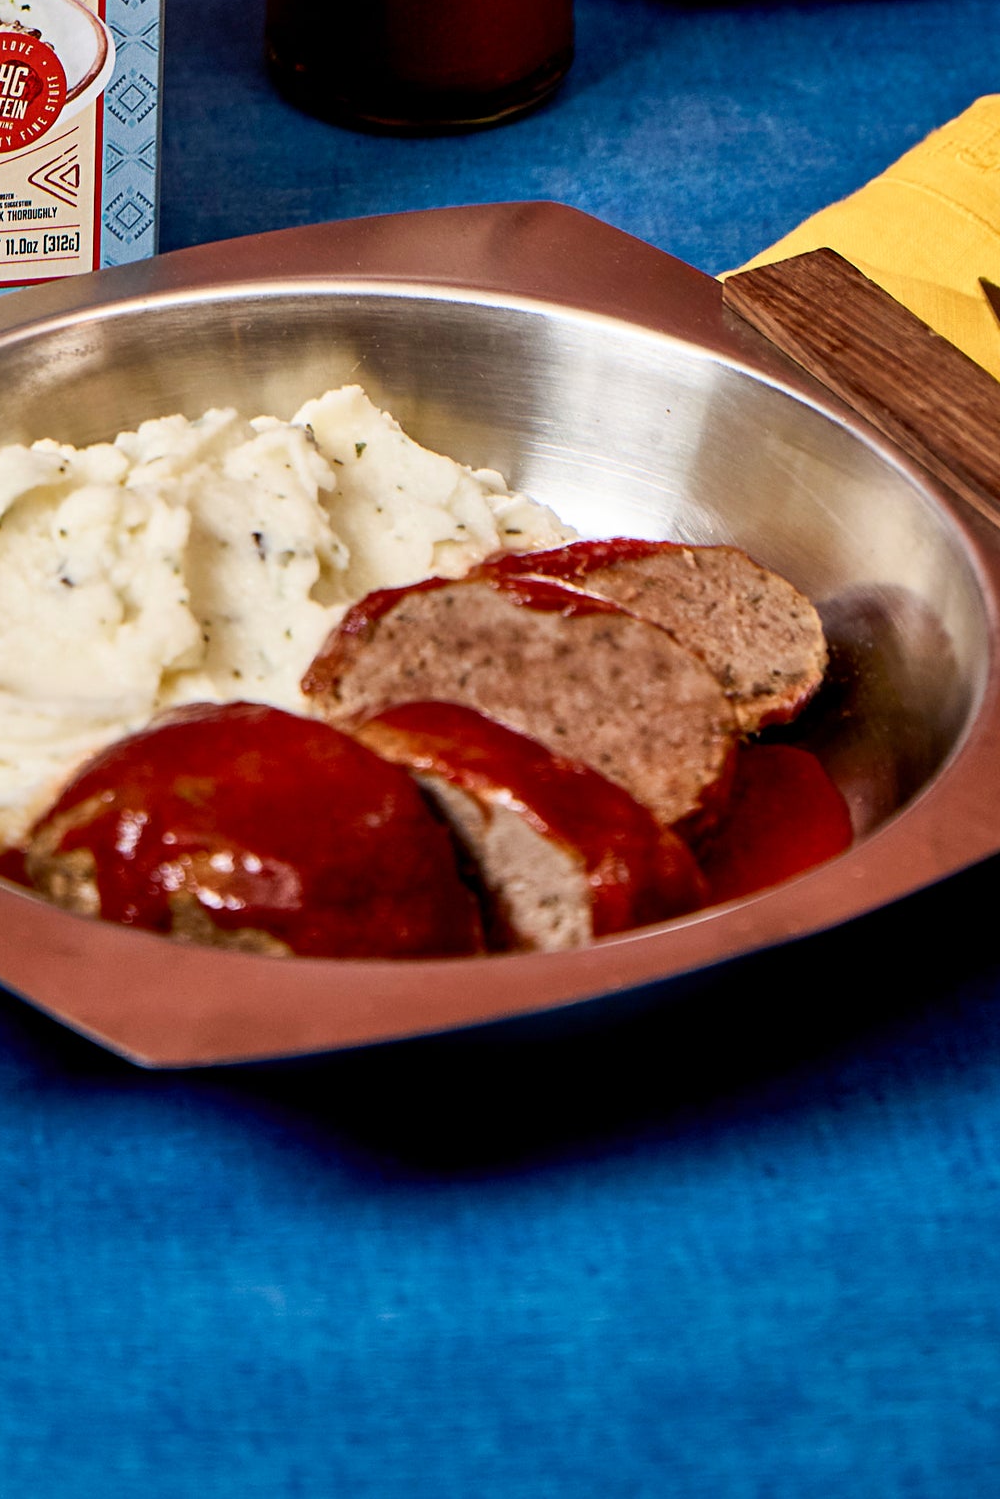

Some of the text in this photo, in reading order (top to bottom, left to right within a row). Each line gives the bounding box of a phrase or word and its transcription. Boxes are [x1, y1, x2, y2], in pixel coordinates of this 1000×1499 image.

[2, 40, 34, 56] LOVE
[20, 116, 48, 141] FINE
[45, 76, 60, 112] STUFF
[7, 206, 58, 222] THOROUGHLY
